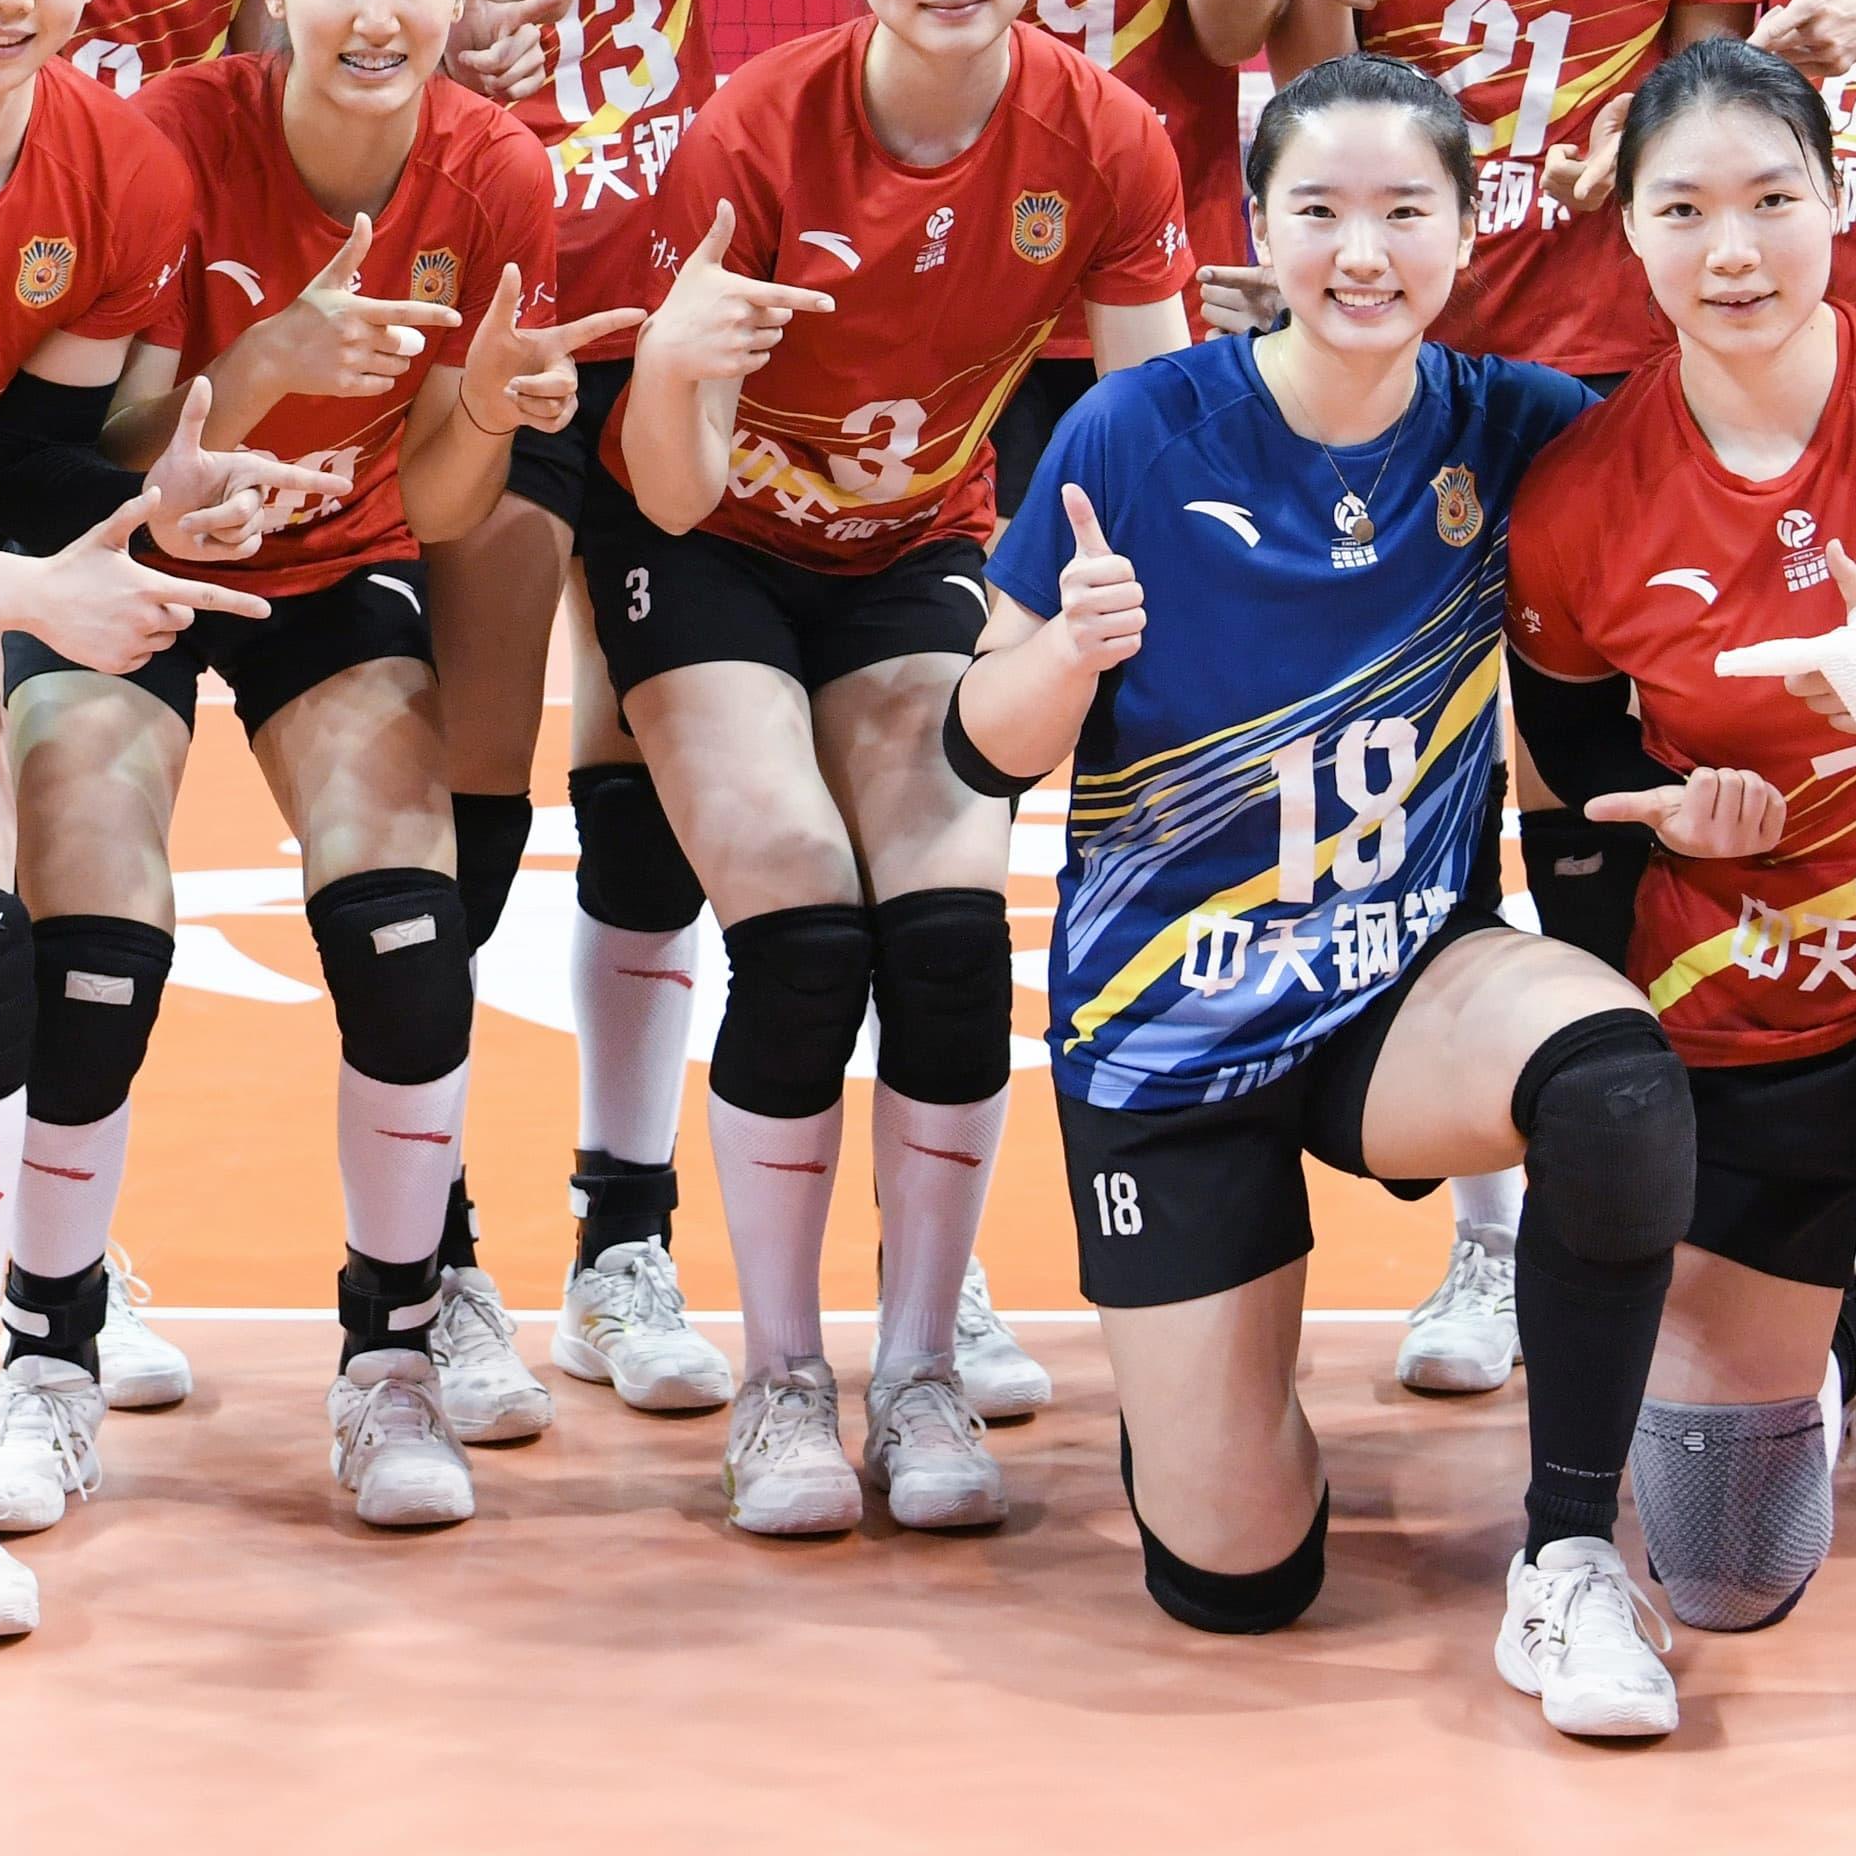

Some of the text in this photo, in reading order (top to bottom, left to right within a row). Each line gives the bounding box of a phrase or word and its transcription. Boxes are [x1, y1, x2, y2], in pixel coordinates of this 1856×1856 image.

[829, 397, 928, 504] 3
[624, 566, 652, 623] 3
[1270, 716, 1420, 905] 18
[1093, 1172, 1143, 1237] 18
